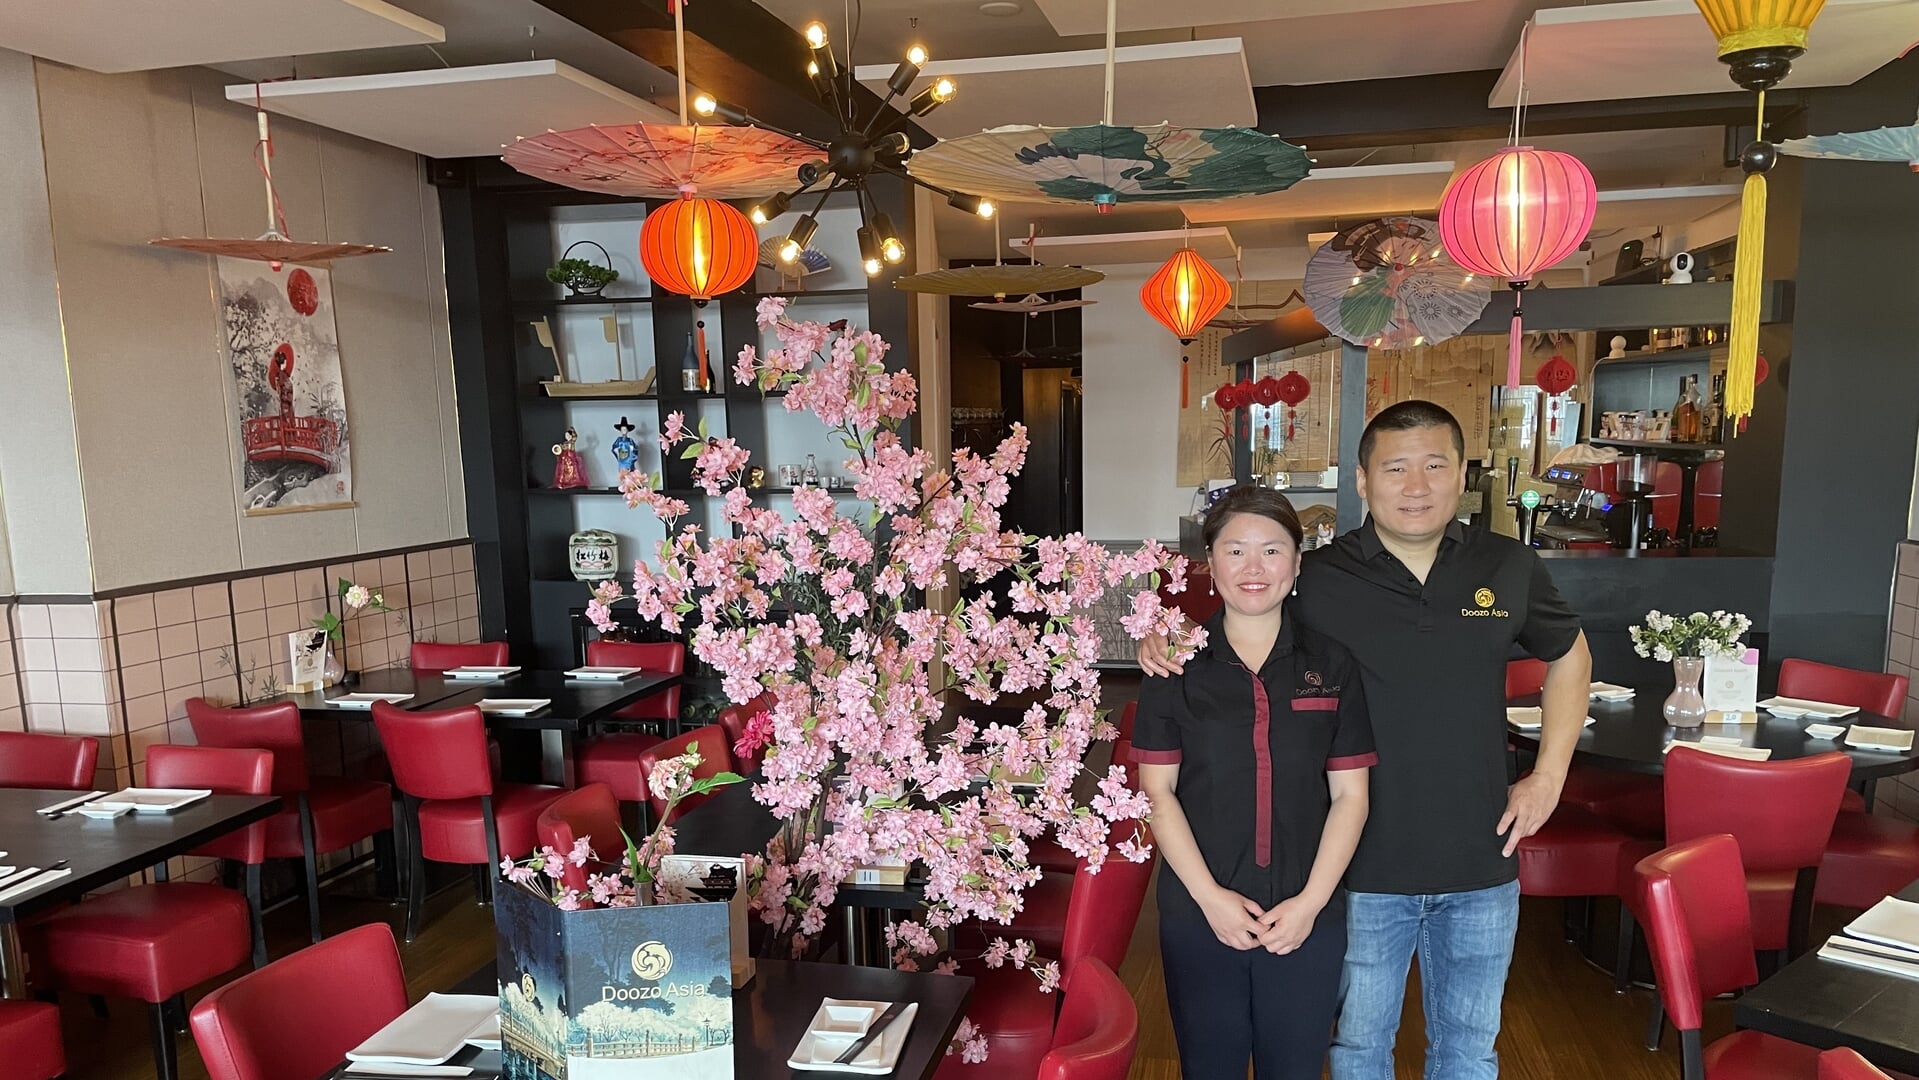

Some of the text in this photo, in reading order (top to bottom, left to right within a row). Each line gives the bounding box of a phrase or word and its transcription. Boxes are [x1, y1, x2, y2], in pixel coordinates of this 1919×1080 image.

[1461, 608, 1509, 618] Doozo Asia
[602, 980, 705, 1002] Doozo Asia
